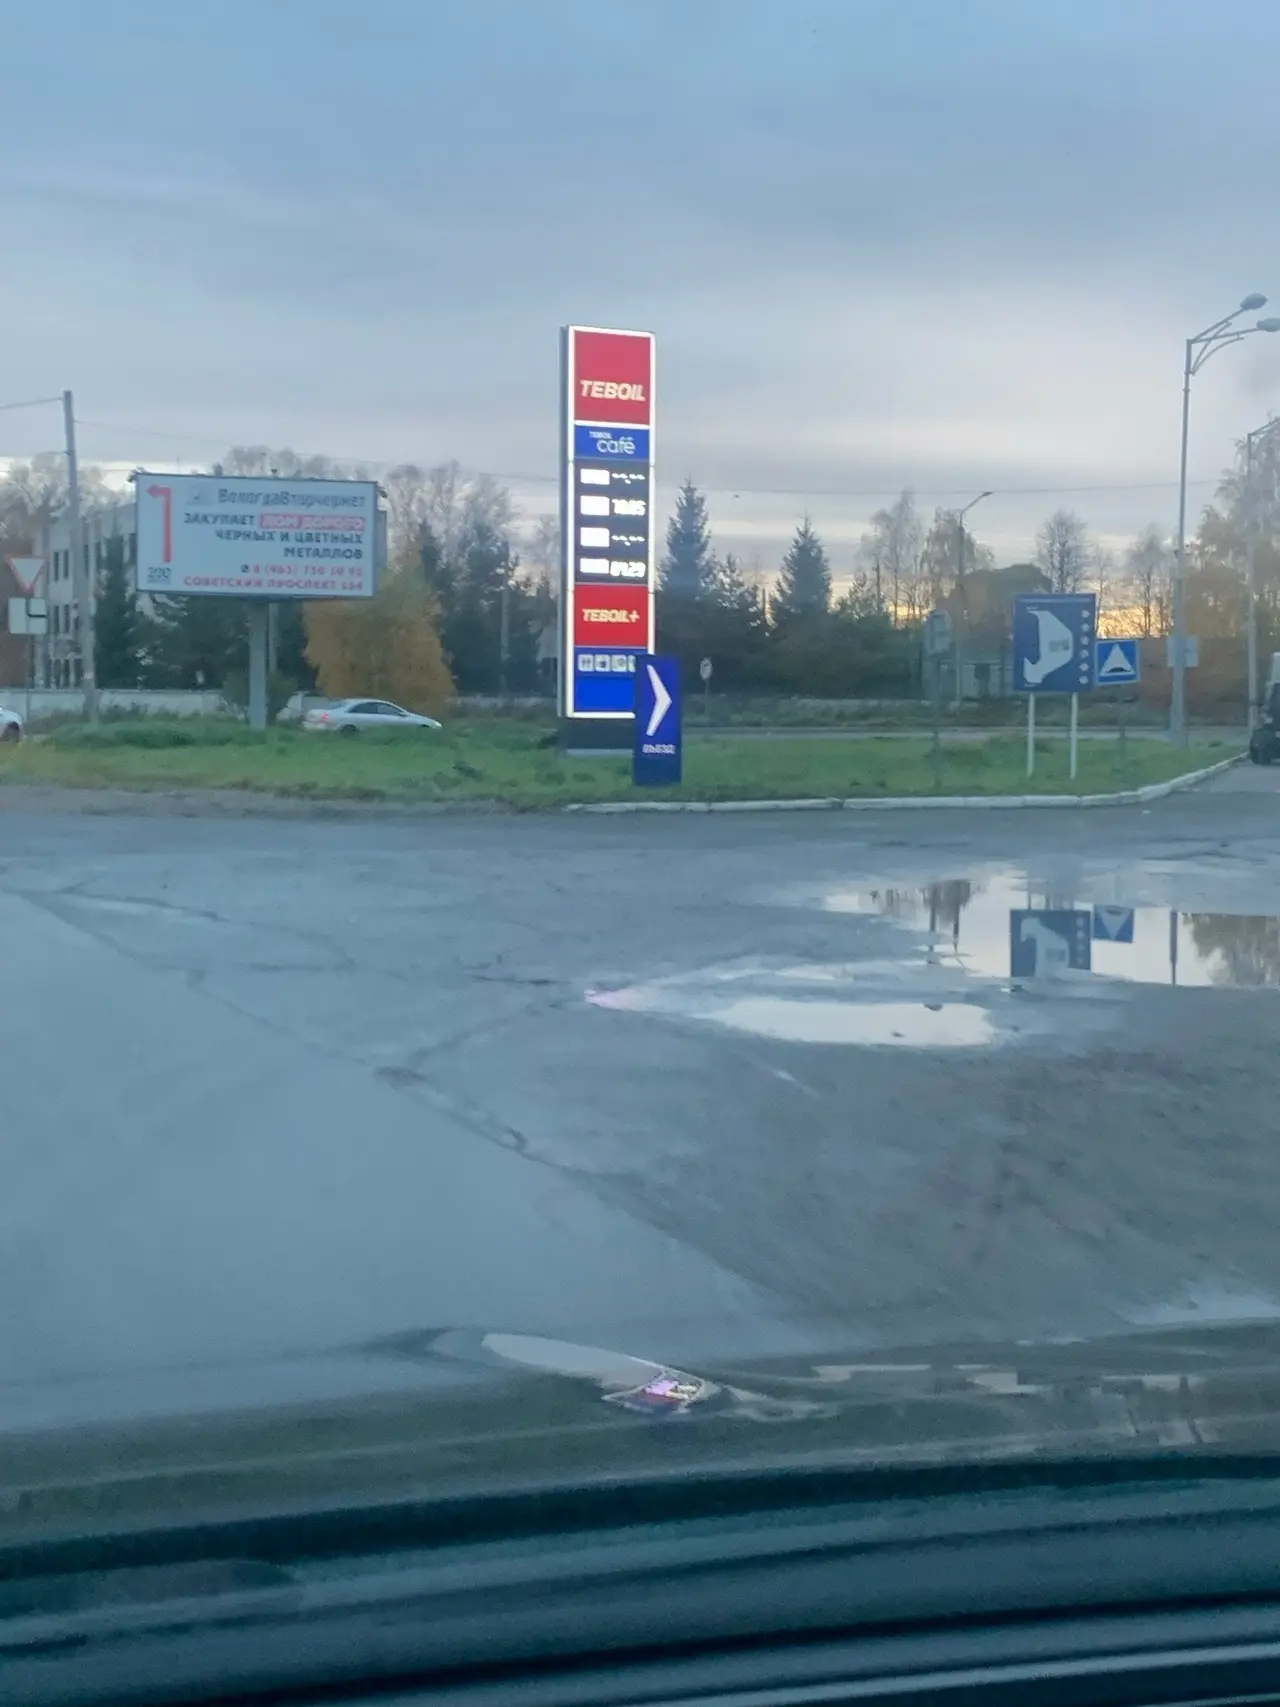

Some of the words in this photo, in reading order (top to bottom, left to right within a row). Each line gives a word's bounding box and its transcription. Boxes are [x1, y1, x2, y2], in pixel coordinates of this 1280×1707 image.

[580, 380, 646, 401] TEBOIL
[184, 513, 255, 525] ЗАКУПАЕТ
[215, 530, 276, 542] ЧЕРНЫХ
[280, 532, 291, 543] И
[295, 533, 363, 545] ЦВЕТНЫХ
[284, 547, 363, 559] МЕТАЛЛОВ
[267, 579, 336, 589] ПРОСПЕКТ
